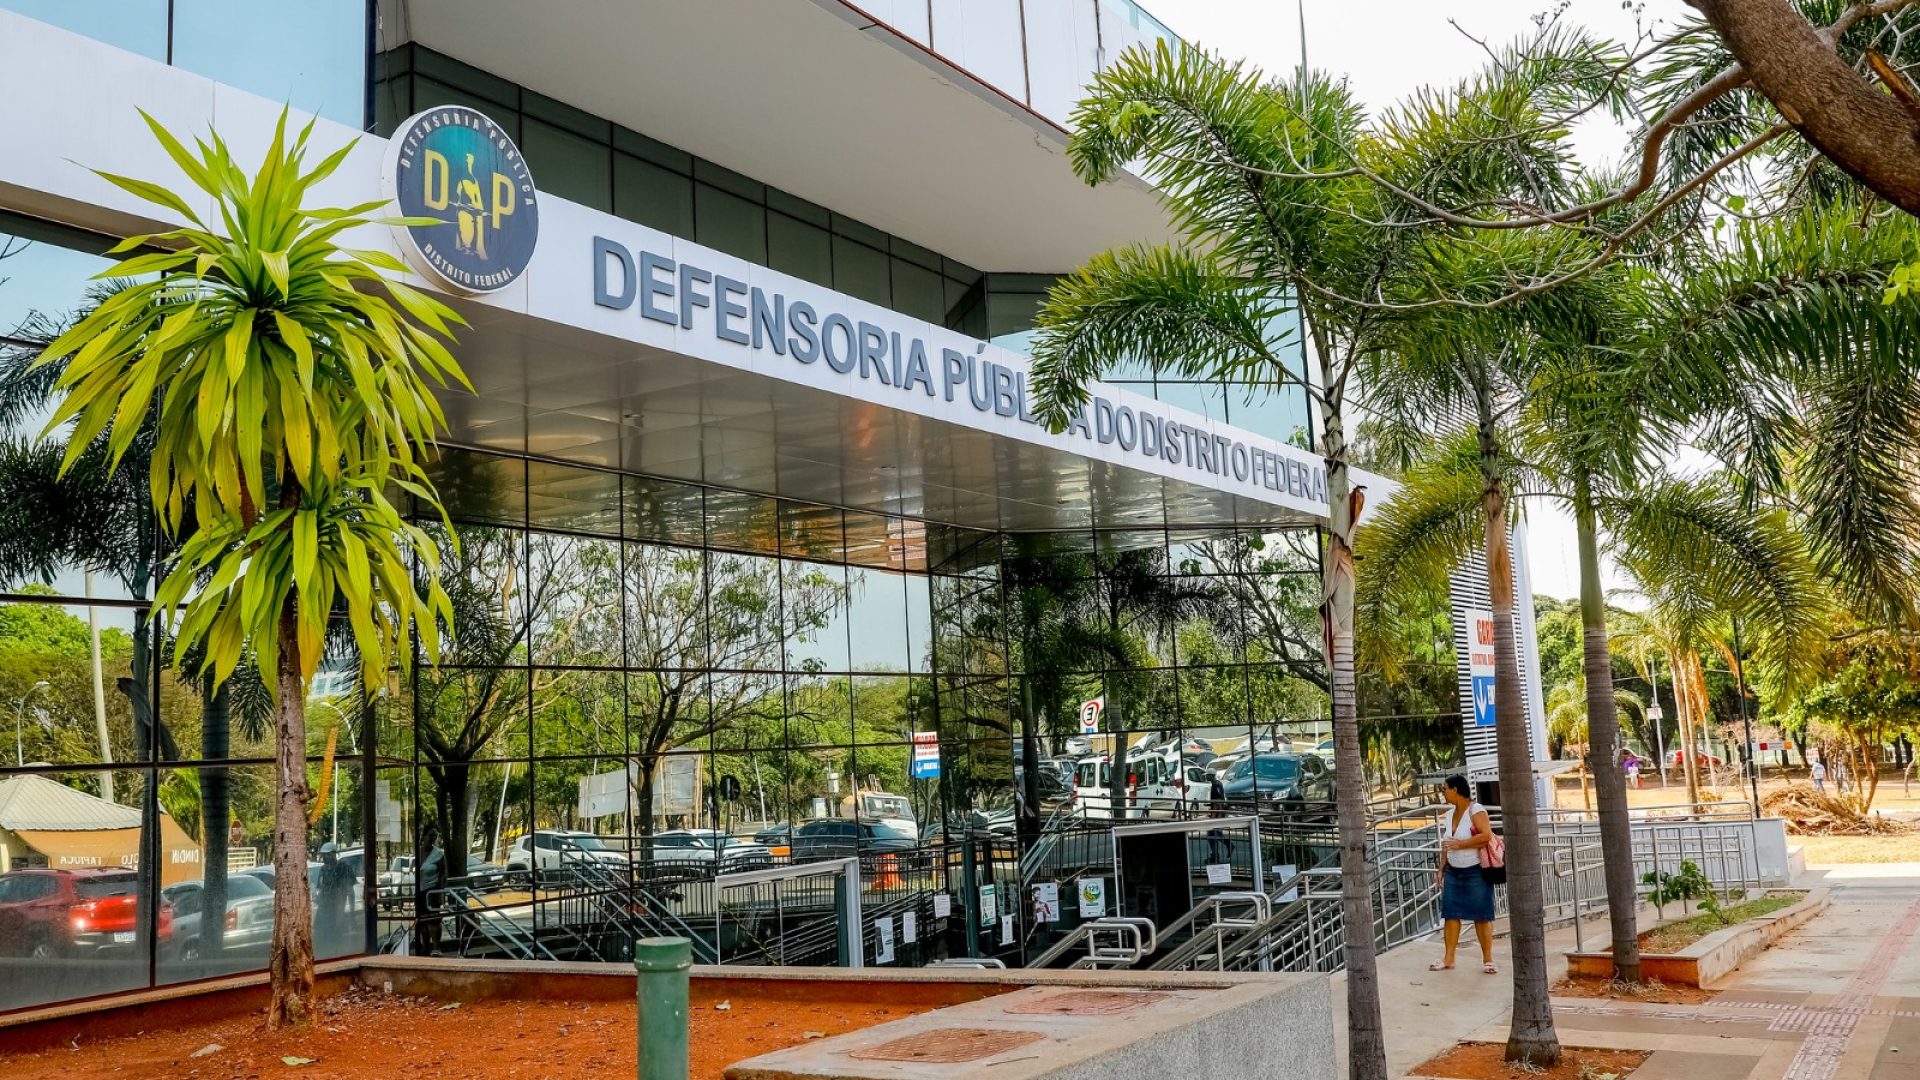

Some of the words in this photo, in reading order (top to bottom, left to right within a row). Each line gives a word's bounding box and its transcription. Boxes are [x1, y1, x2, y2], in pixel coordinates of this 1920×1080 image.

[401, 112, 480, 169] DEFENSORIA
[424, 243, 471, 284] DISTRITO
[474, 268, 514, 287] FEDERAL
[593, 235, 936, 396] DEFENSORIA
[943, 342, 1093, 440] PÚBLA
[1094, 396, 1137, 452] DO
[1140, 411, 1249, 482] DISTRITO
